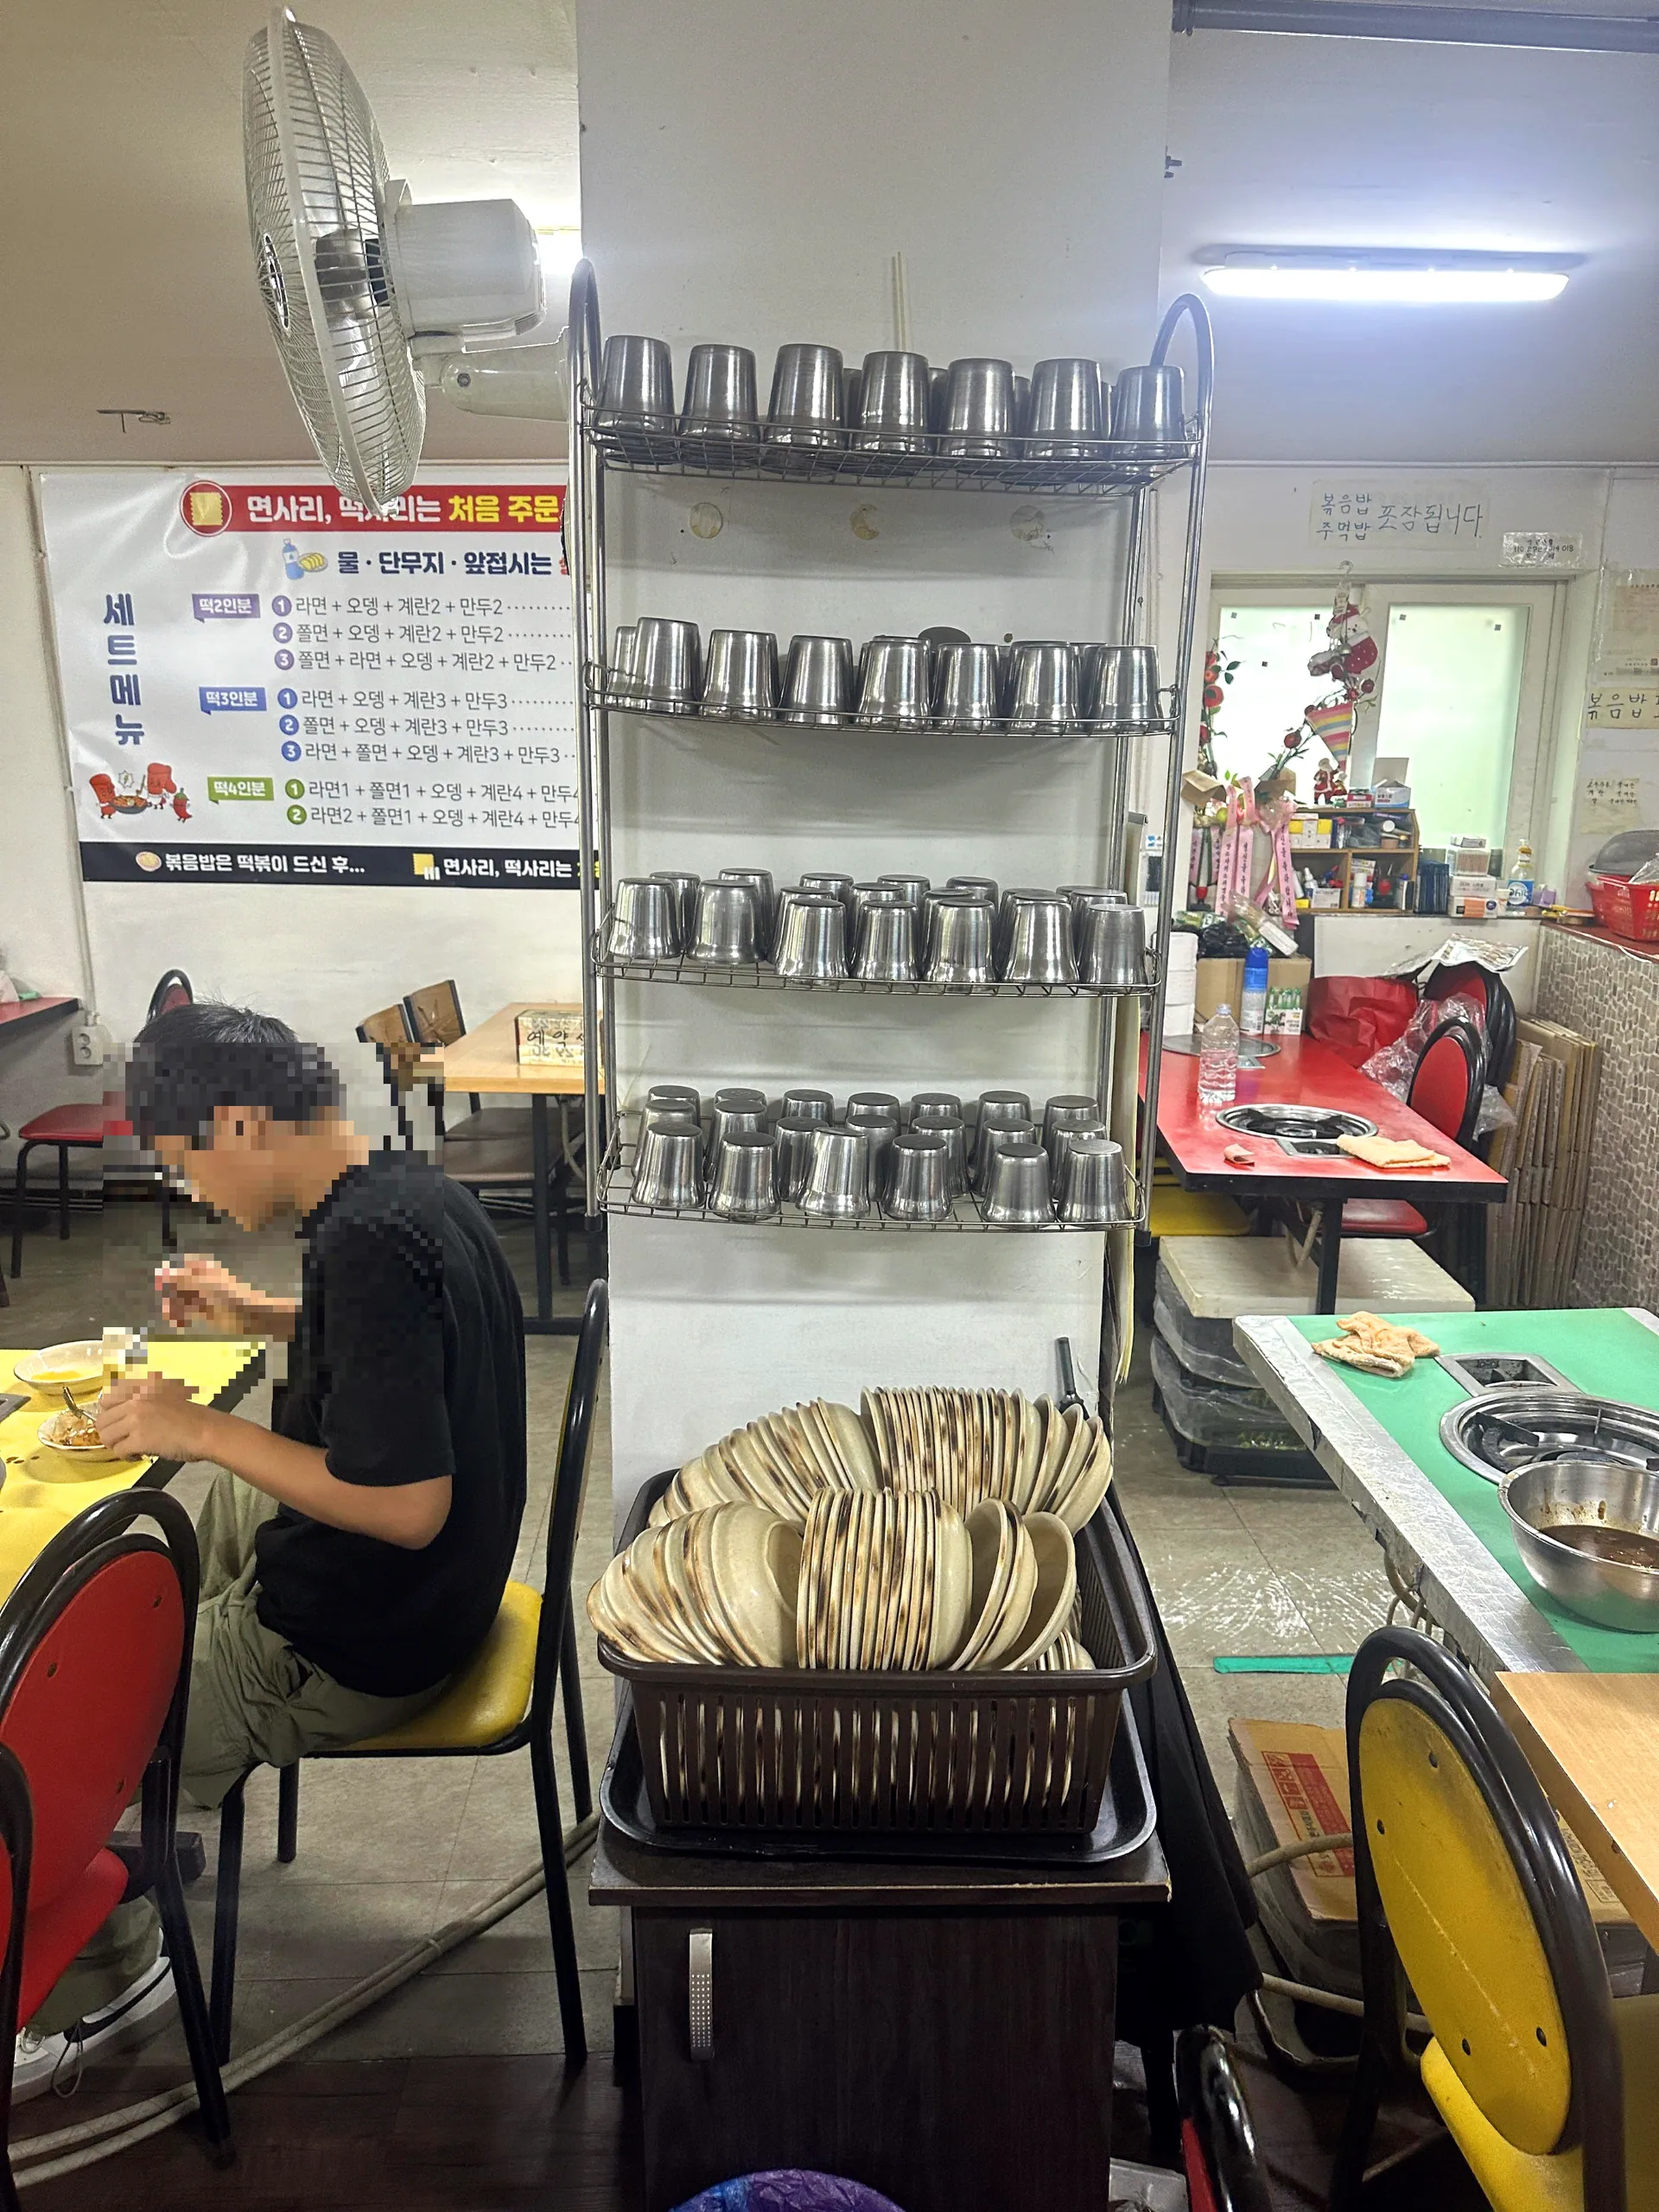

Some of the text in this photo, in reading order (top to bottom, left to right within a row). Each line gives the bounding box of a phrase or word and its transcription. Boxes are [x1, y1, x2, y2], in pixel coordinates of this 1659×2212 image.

[247, 494, 558, 524] 면사리, 떡리는 처음 주문
[1321, 493, 1372, 516] 볶음밥
[1316, 520, 1370, 541] 주먹밥
[337, 551, 360, 575] 물
[378, 551, 445, 575] 단무지
[463, 550, 551, 575] 앞접시는
[199, 597, 252, 615] 떡2인분
[296, 597, 327, 615] 라면
[347, 597, 378, 616] 오뎅
[398, 597, 441, 616] 계란2
[461, 597, 503, 616] 만두2
[296, 624, 328, 643] 쫄면
[348, 624, 379, 643] 오뎅
[399, 625, 442, 644] 계란2
[461, 626, 504, 644] 만두2
[103, 593, 145, 745] 세트메뉴
[299, 651, 330, 670] 쫄면
[350, 651, 381, 670] 라면
[401, 652, 432, 671] 오뎅
[453, 652, 494, 671] 계란2
[513, 653, 556, 671] 만두2
[206, 691, 258, 708] 떡3인분
[302, 690, 334, 709] 라면
[353, 690, 384, 709] 오뎅
[404, 691, 446, 709] 계란3
[466, 691, 507, 710] 만두3
[1587, 693, 1647, 720] 볶음밥
[304, 716, 334, 734] 쫄면
[354, 717, 385, 735] 오뎅
[405, 718, 448, 735] 계란3
[467, 718, 508, 737] 만두3
[305, 743, 337, 761] 라면
[356, 743, 387, 762] 쫄면
[407, 745, 438, 763] 오뎅
[457, 746, 499, 764] 계란3
[518, 747, 560, 765] 만두3
[213, 780, 266, 797] 떡4인분
[309, 780, 349, 799] 라면1
[370, 781, 410, 800] 쫄면1
[431, 783, 461, 801] 오뎅
[481, 784, 523, 802] 계란4
[311, 806, 353, 825] 라면2
[372, 808, 410, 826] 쫄면1
[433, 809, 463, 827] 오뎅
[482, 810, 524, 828] 계란4
[165, 853, 365, 874] 볶음밥은 떡볶이 드신 후...
[442, 858, 500, 878] 면사리,
[505, 860, 573, 878] 떡사리는
